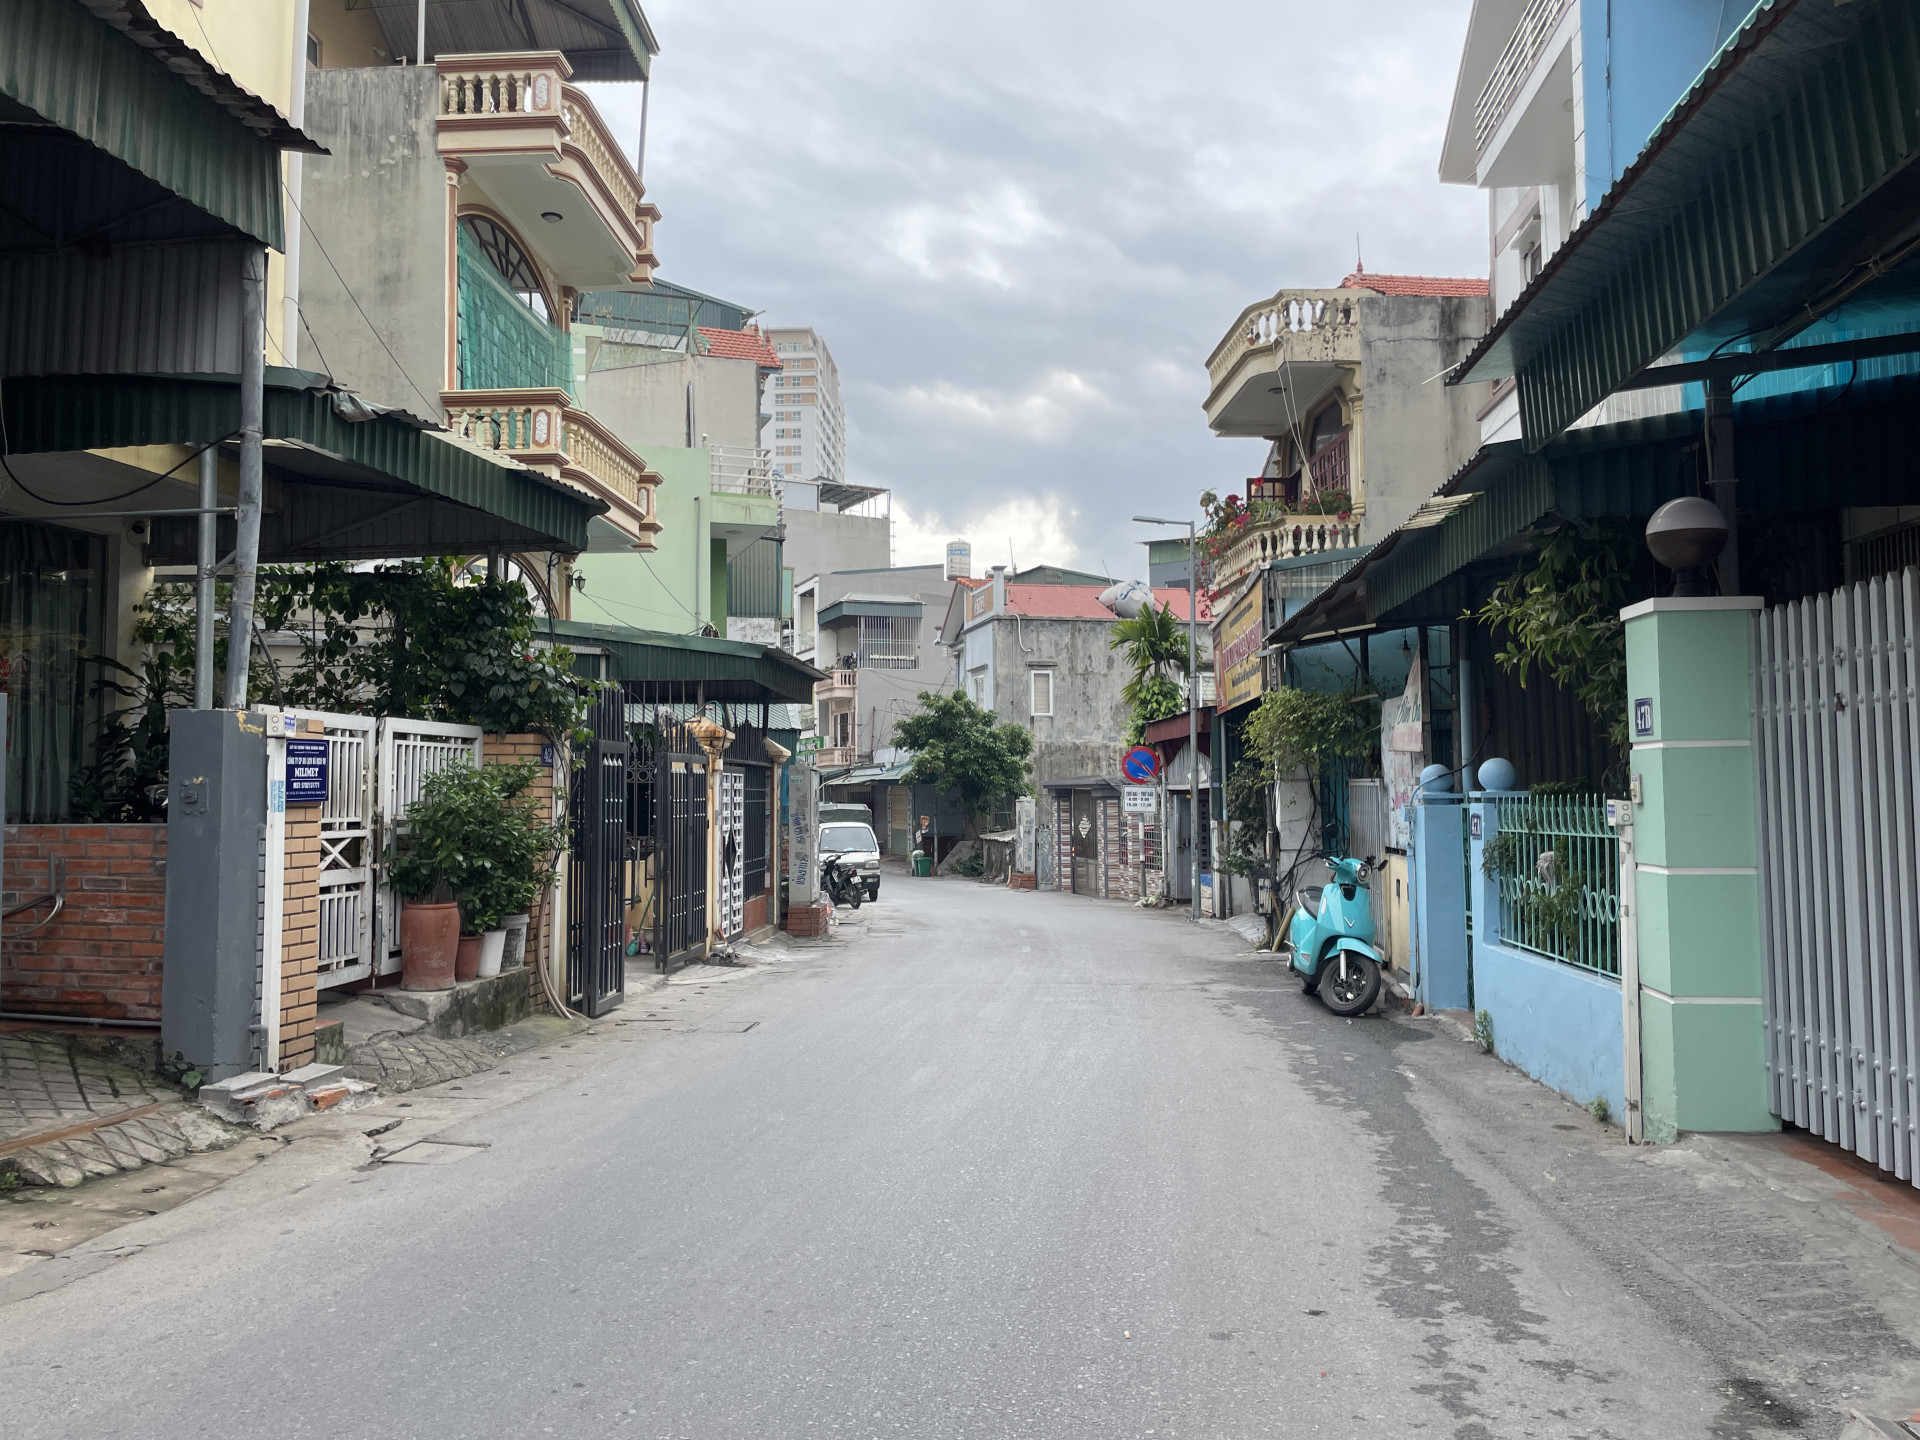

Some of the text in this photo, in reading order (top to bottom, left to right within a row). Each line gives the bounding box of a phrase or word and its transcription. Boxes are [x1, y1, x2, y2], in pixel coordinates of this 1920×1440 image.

[1637, 705, 1651, 730] 47B
[295, 757, 298, 765] TY
[544, 747, 552, 762] 42
